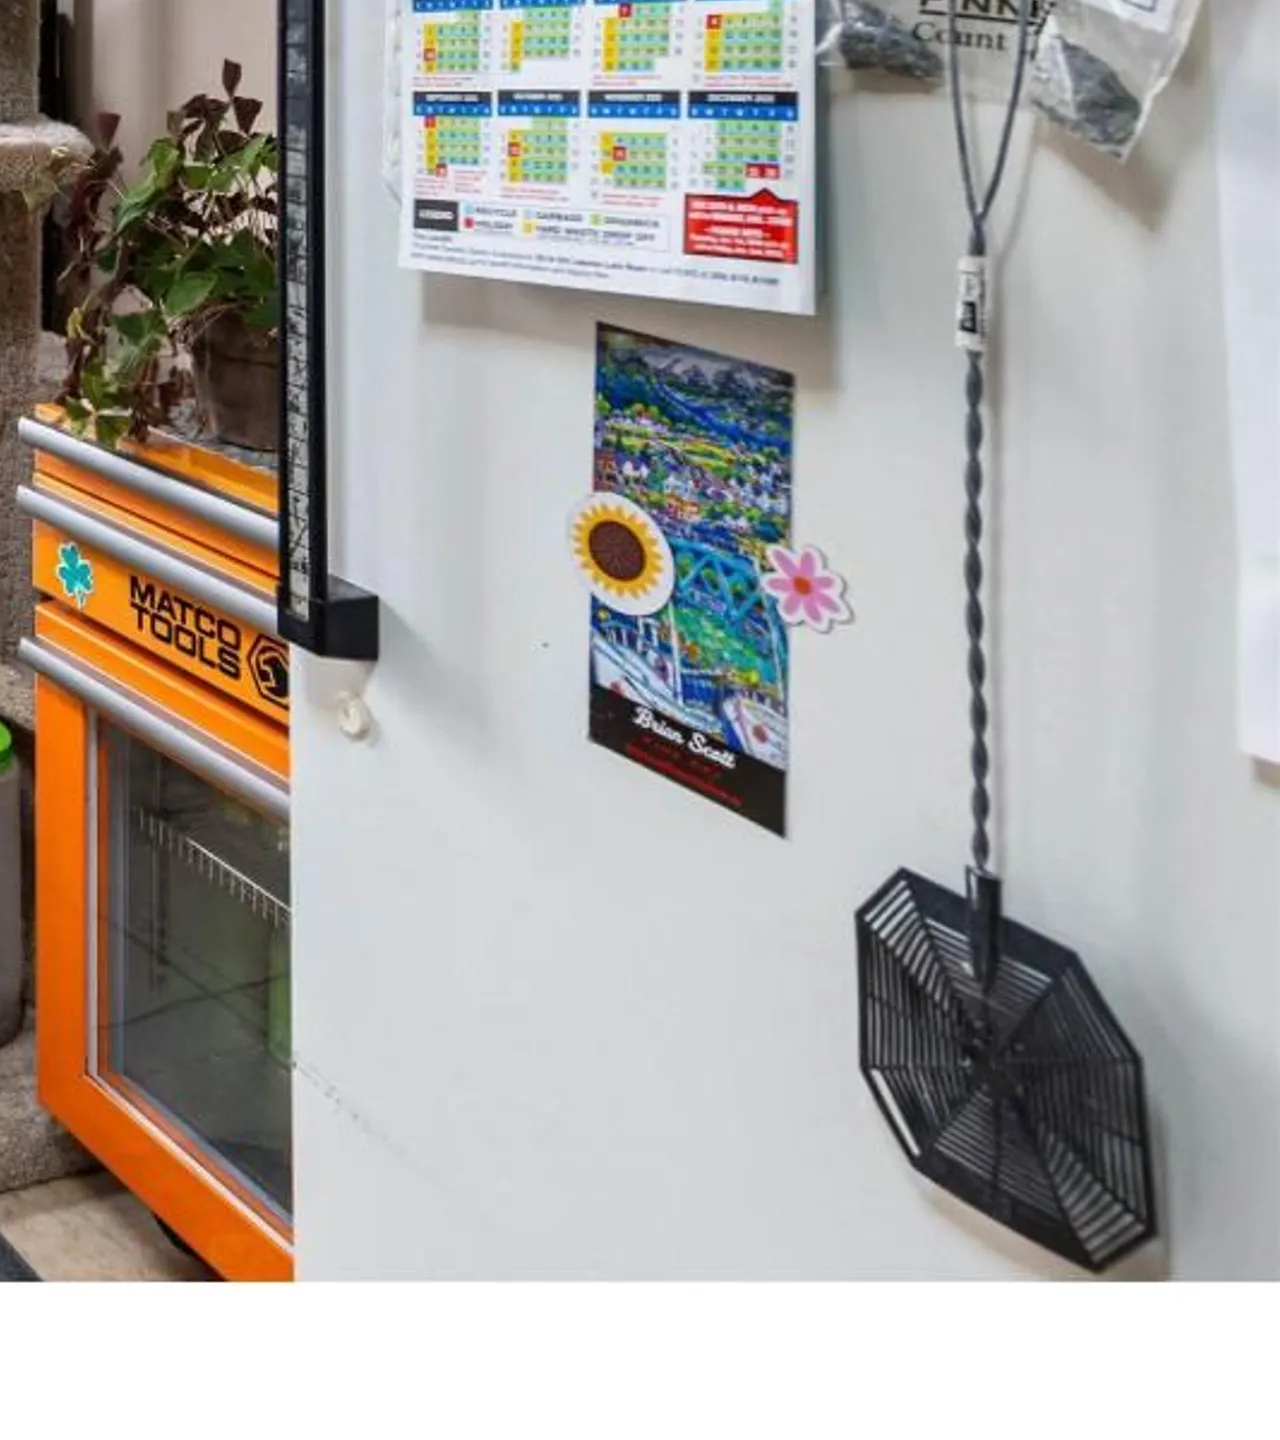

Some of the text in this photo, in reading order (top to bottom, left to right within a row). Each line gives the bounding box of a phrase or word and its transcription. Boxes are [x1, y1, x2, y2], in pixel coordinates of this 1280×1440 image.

[130, 575, 241, 651] MATCO
[130, 601, 240, 681] TOOLS
[633, 706, 737, 769] Brian Scott
